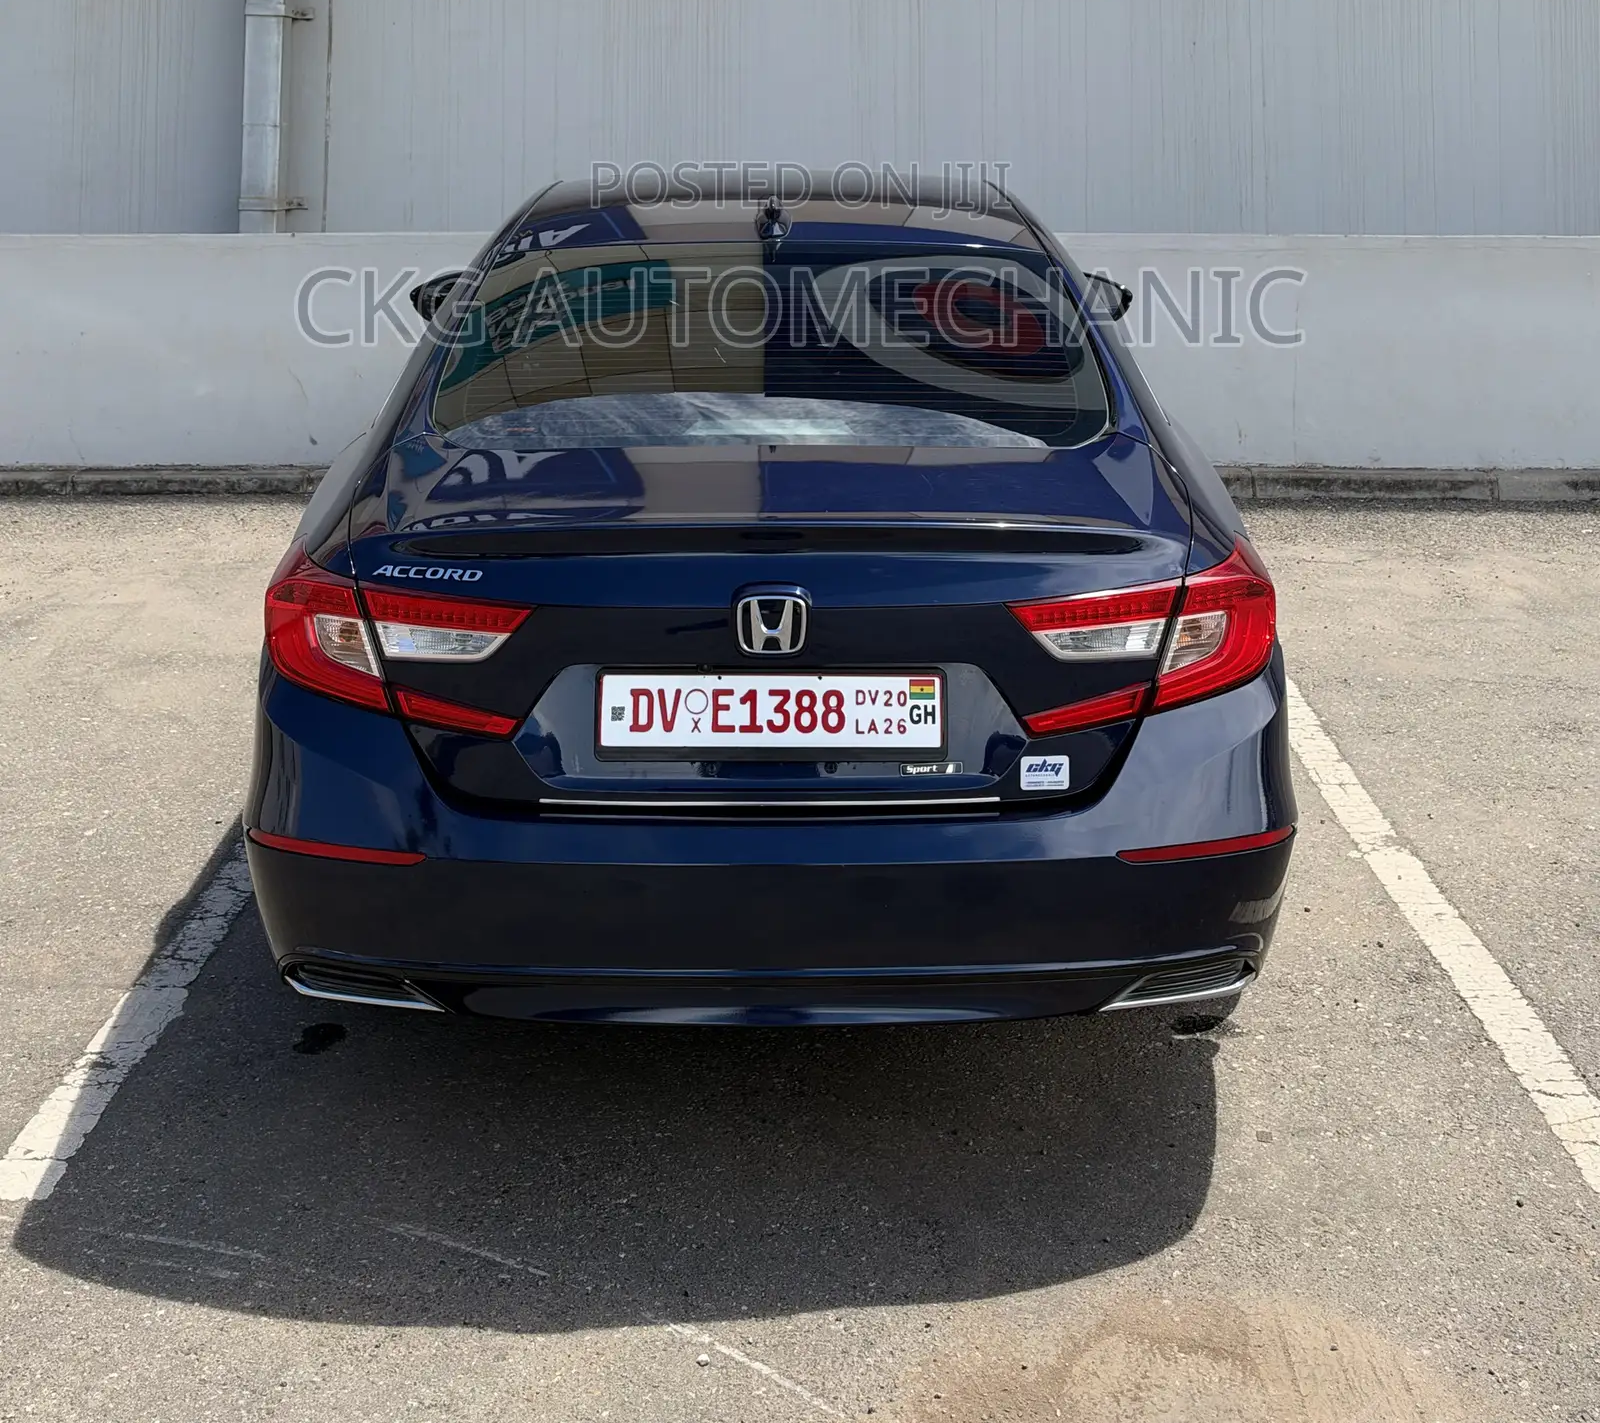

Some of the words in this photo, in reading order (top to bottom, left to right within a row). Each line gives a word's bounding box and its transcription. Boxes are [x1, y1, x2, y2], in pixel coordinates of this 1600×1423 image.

[372, 565, 484, 582] ACCORD
[629, 688, 682, 733] DV
[711, 688, 846, 734] E1388
[909, 704, 936, 725] GH
[906, 765, 939, 775] Sport
